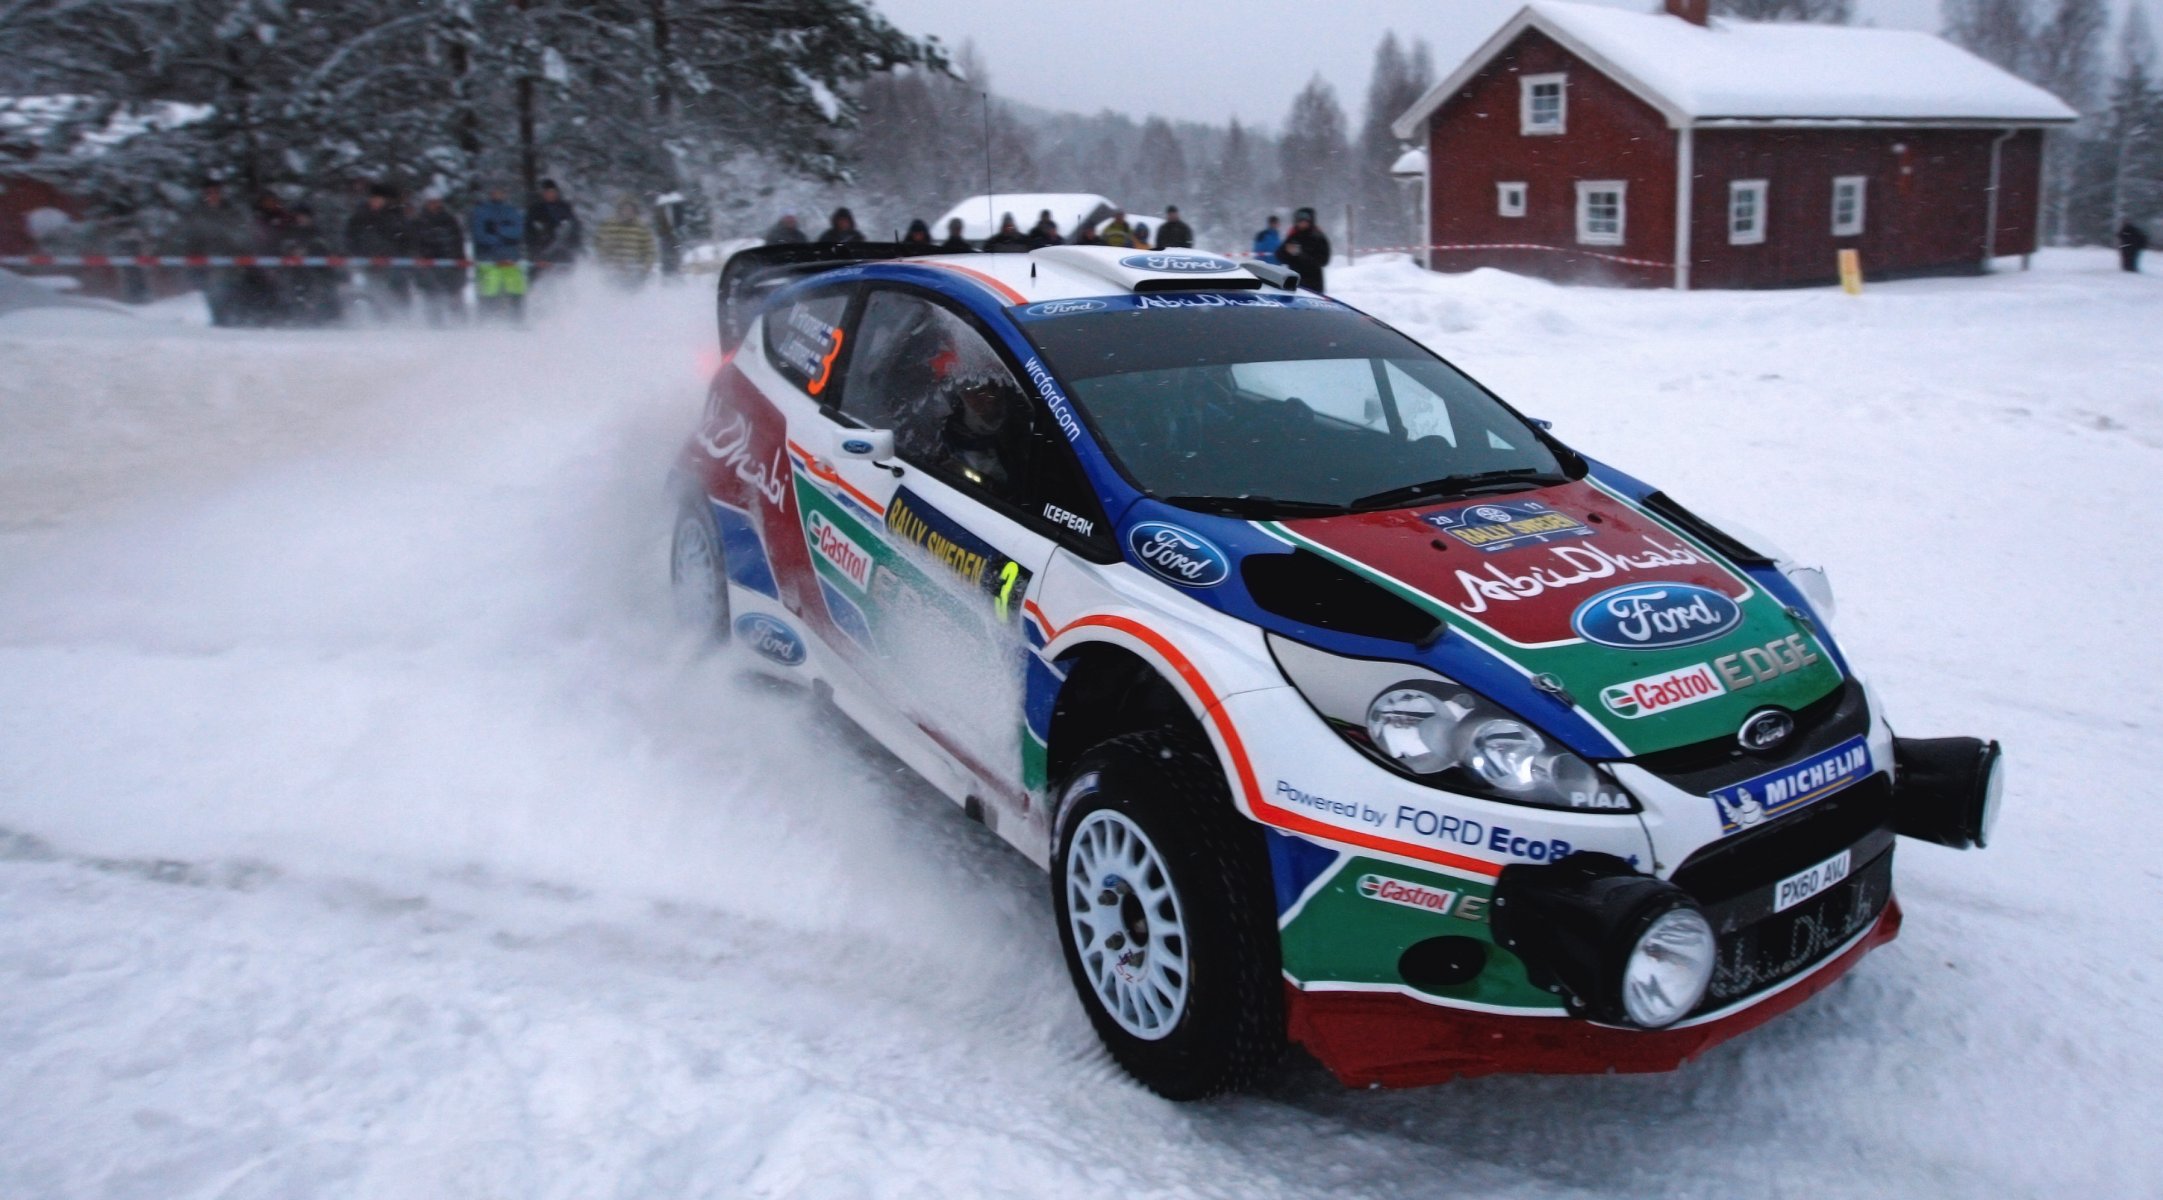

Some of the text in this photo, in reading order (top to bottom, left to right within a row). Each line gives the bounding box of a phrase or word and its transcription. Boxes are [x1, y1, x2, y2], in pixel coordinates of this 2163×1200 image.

[1148, 256, 1222, 270] Ford
[1043, 302, 1094, 314] Ford
[808, 328, 844, 394] 3
[1025, 356, 1081, 442] wrcford.com
[1043, 503, 1094, 537] ICEPEAK
[1429, 515, 1454, 526] 20
[1524, 502, 1544, 510] 11
[888, 498, 987, 586] RALLY SWEDEN
[1453, 513, 1581, 544] RALLY SWEDEN
[820, 525, 868, 585] Castrol
[1141, 529, 1213, 579] Ford
[1607, 590, 1721, 641] Ford
[752, 620, 796, 659] Ford
[1633, 633, 1818, 710] Castrol EDGE
[1765, 745, 1866, 806] MICHELIN
[1570, 791, 1632, 809] PIAA
[1276, 780, 1640, 867] Powered by FORD EcoBt
[1380, 881, 1448, 910] Castrol
[1781, 870, 1819, 907] PX60
